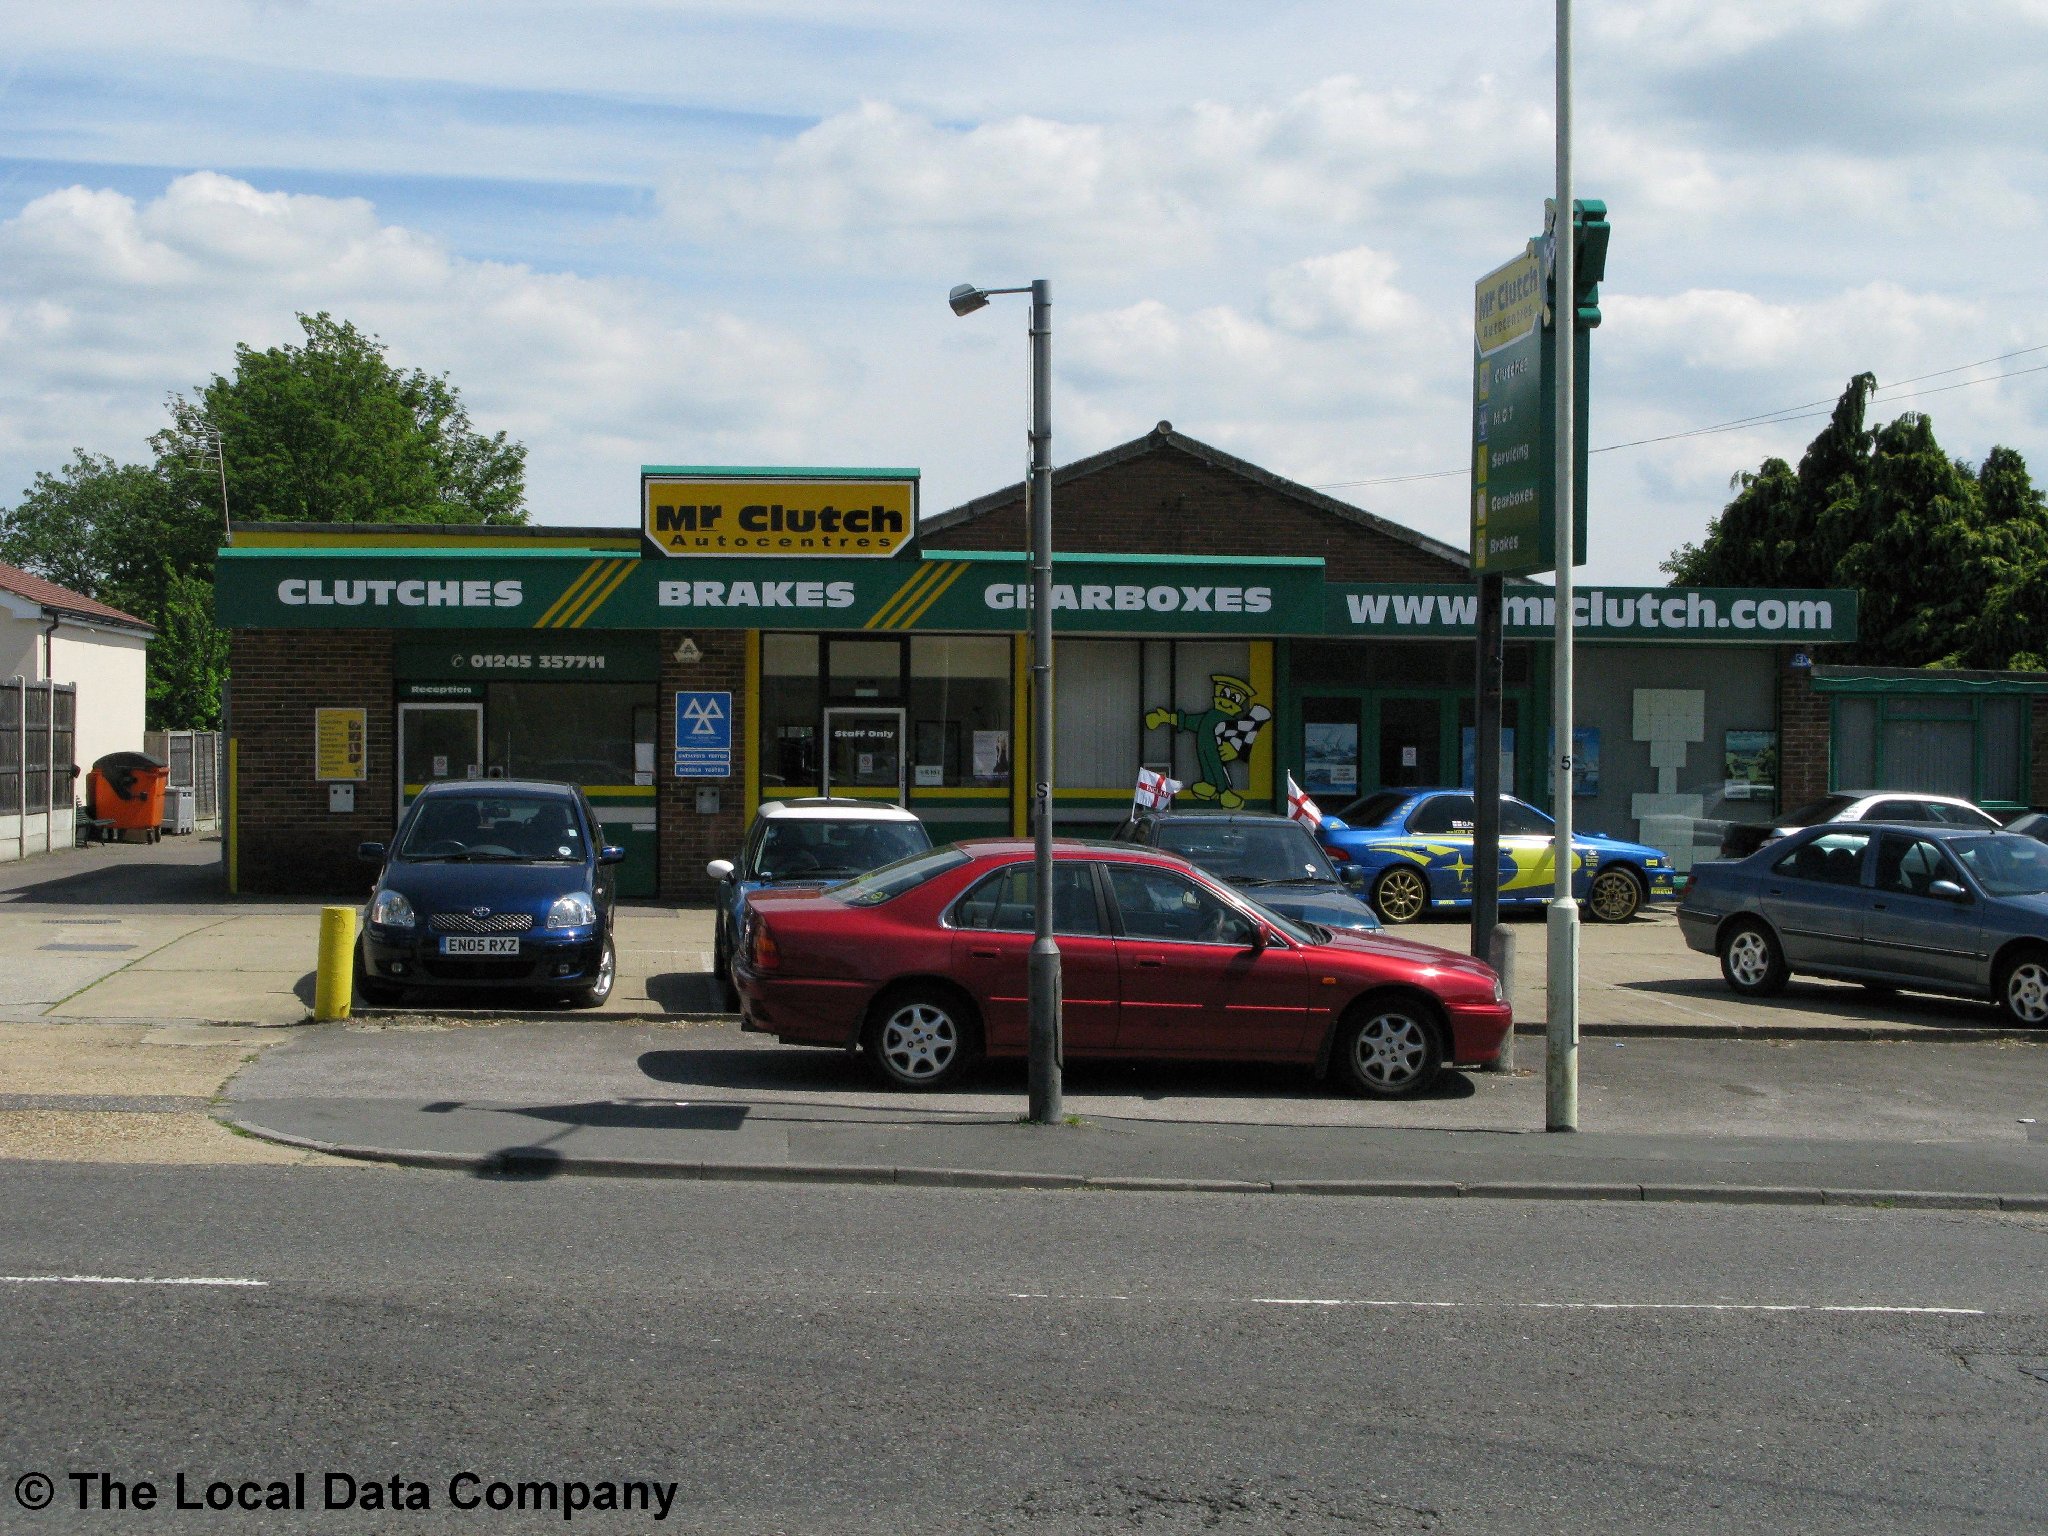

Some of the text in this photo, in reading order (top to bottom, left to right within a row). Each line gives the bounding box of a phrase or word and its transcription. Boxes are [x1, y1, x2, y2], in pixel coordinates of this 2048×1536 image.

[1498, 266, 1538, 312] Clutch
[1491, 443, 1529, 469] Servicing
[1491, 487, 1534, 512] Gearboxes
[656, 504, 903, 533] Mr Clutch
[669, 534, 892, 548] Autocentres
[1489, 535, 1519, 554] Brakes
[277, 579, 523, 607] CLUTCHES
[658, 580, 855, 608] BRAKES
[1347, 591, 1832, 629] wwwmrclutch.com
[471, 655, 605, 669] 01245 357711
[411, 685, 472, 694] Reception
[834, 730, 894, 739] Staff Only
[1561, 755, 1571, 771] 5
[449, 940, 517, 952] EN05 RXZ
